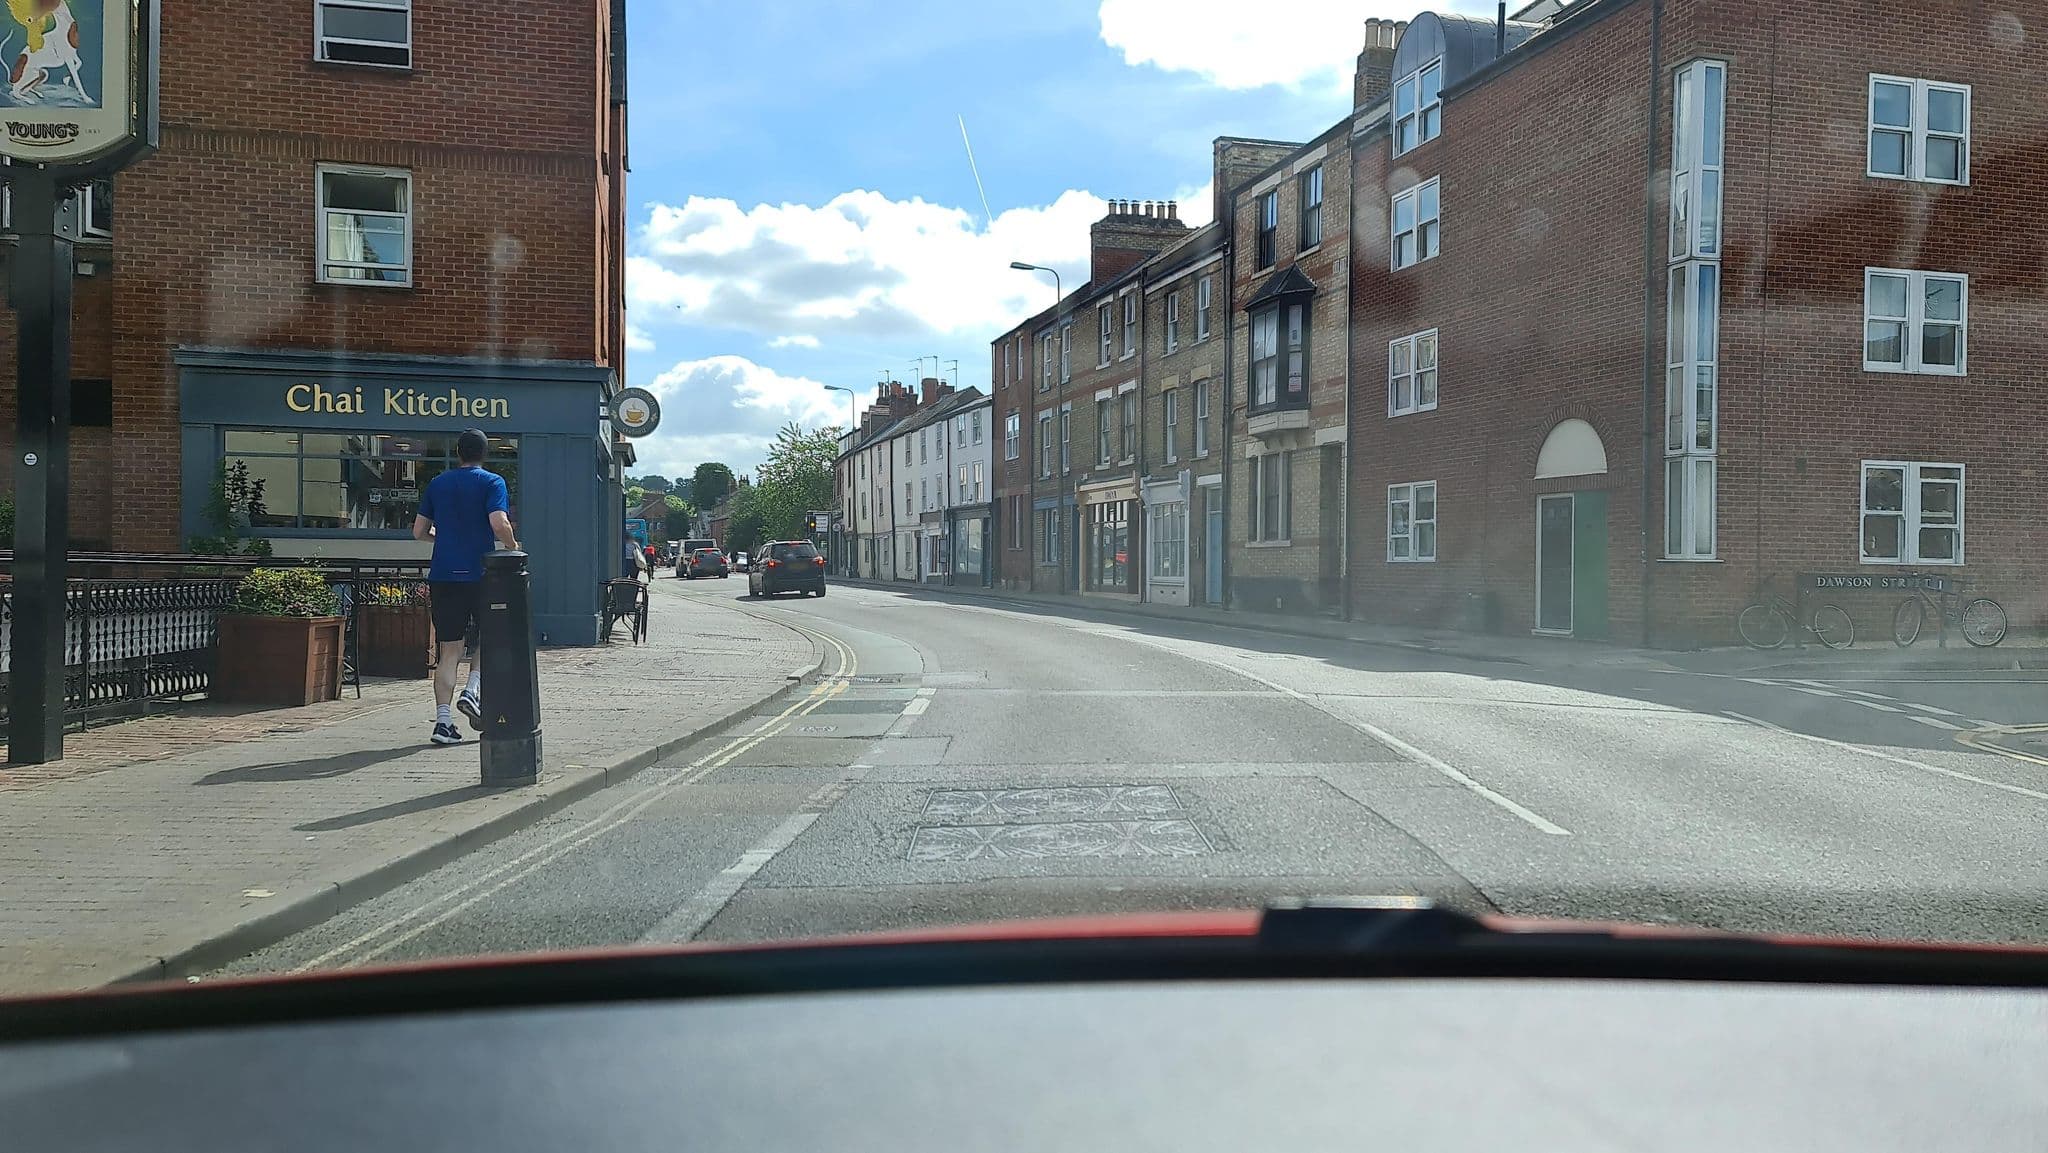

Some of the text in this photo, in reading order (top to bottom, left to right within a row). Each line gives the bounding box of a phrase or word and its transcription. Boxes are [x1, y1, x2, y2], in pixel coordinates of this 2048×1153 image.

[5, 121, 79, 139] YOUNG'S
[286, 383, 510, 418] Chai Kitchen
[1816, 577, 1932, 588] DAWSON STRT
